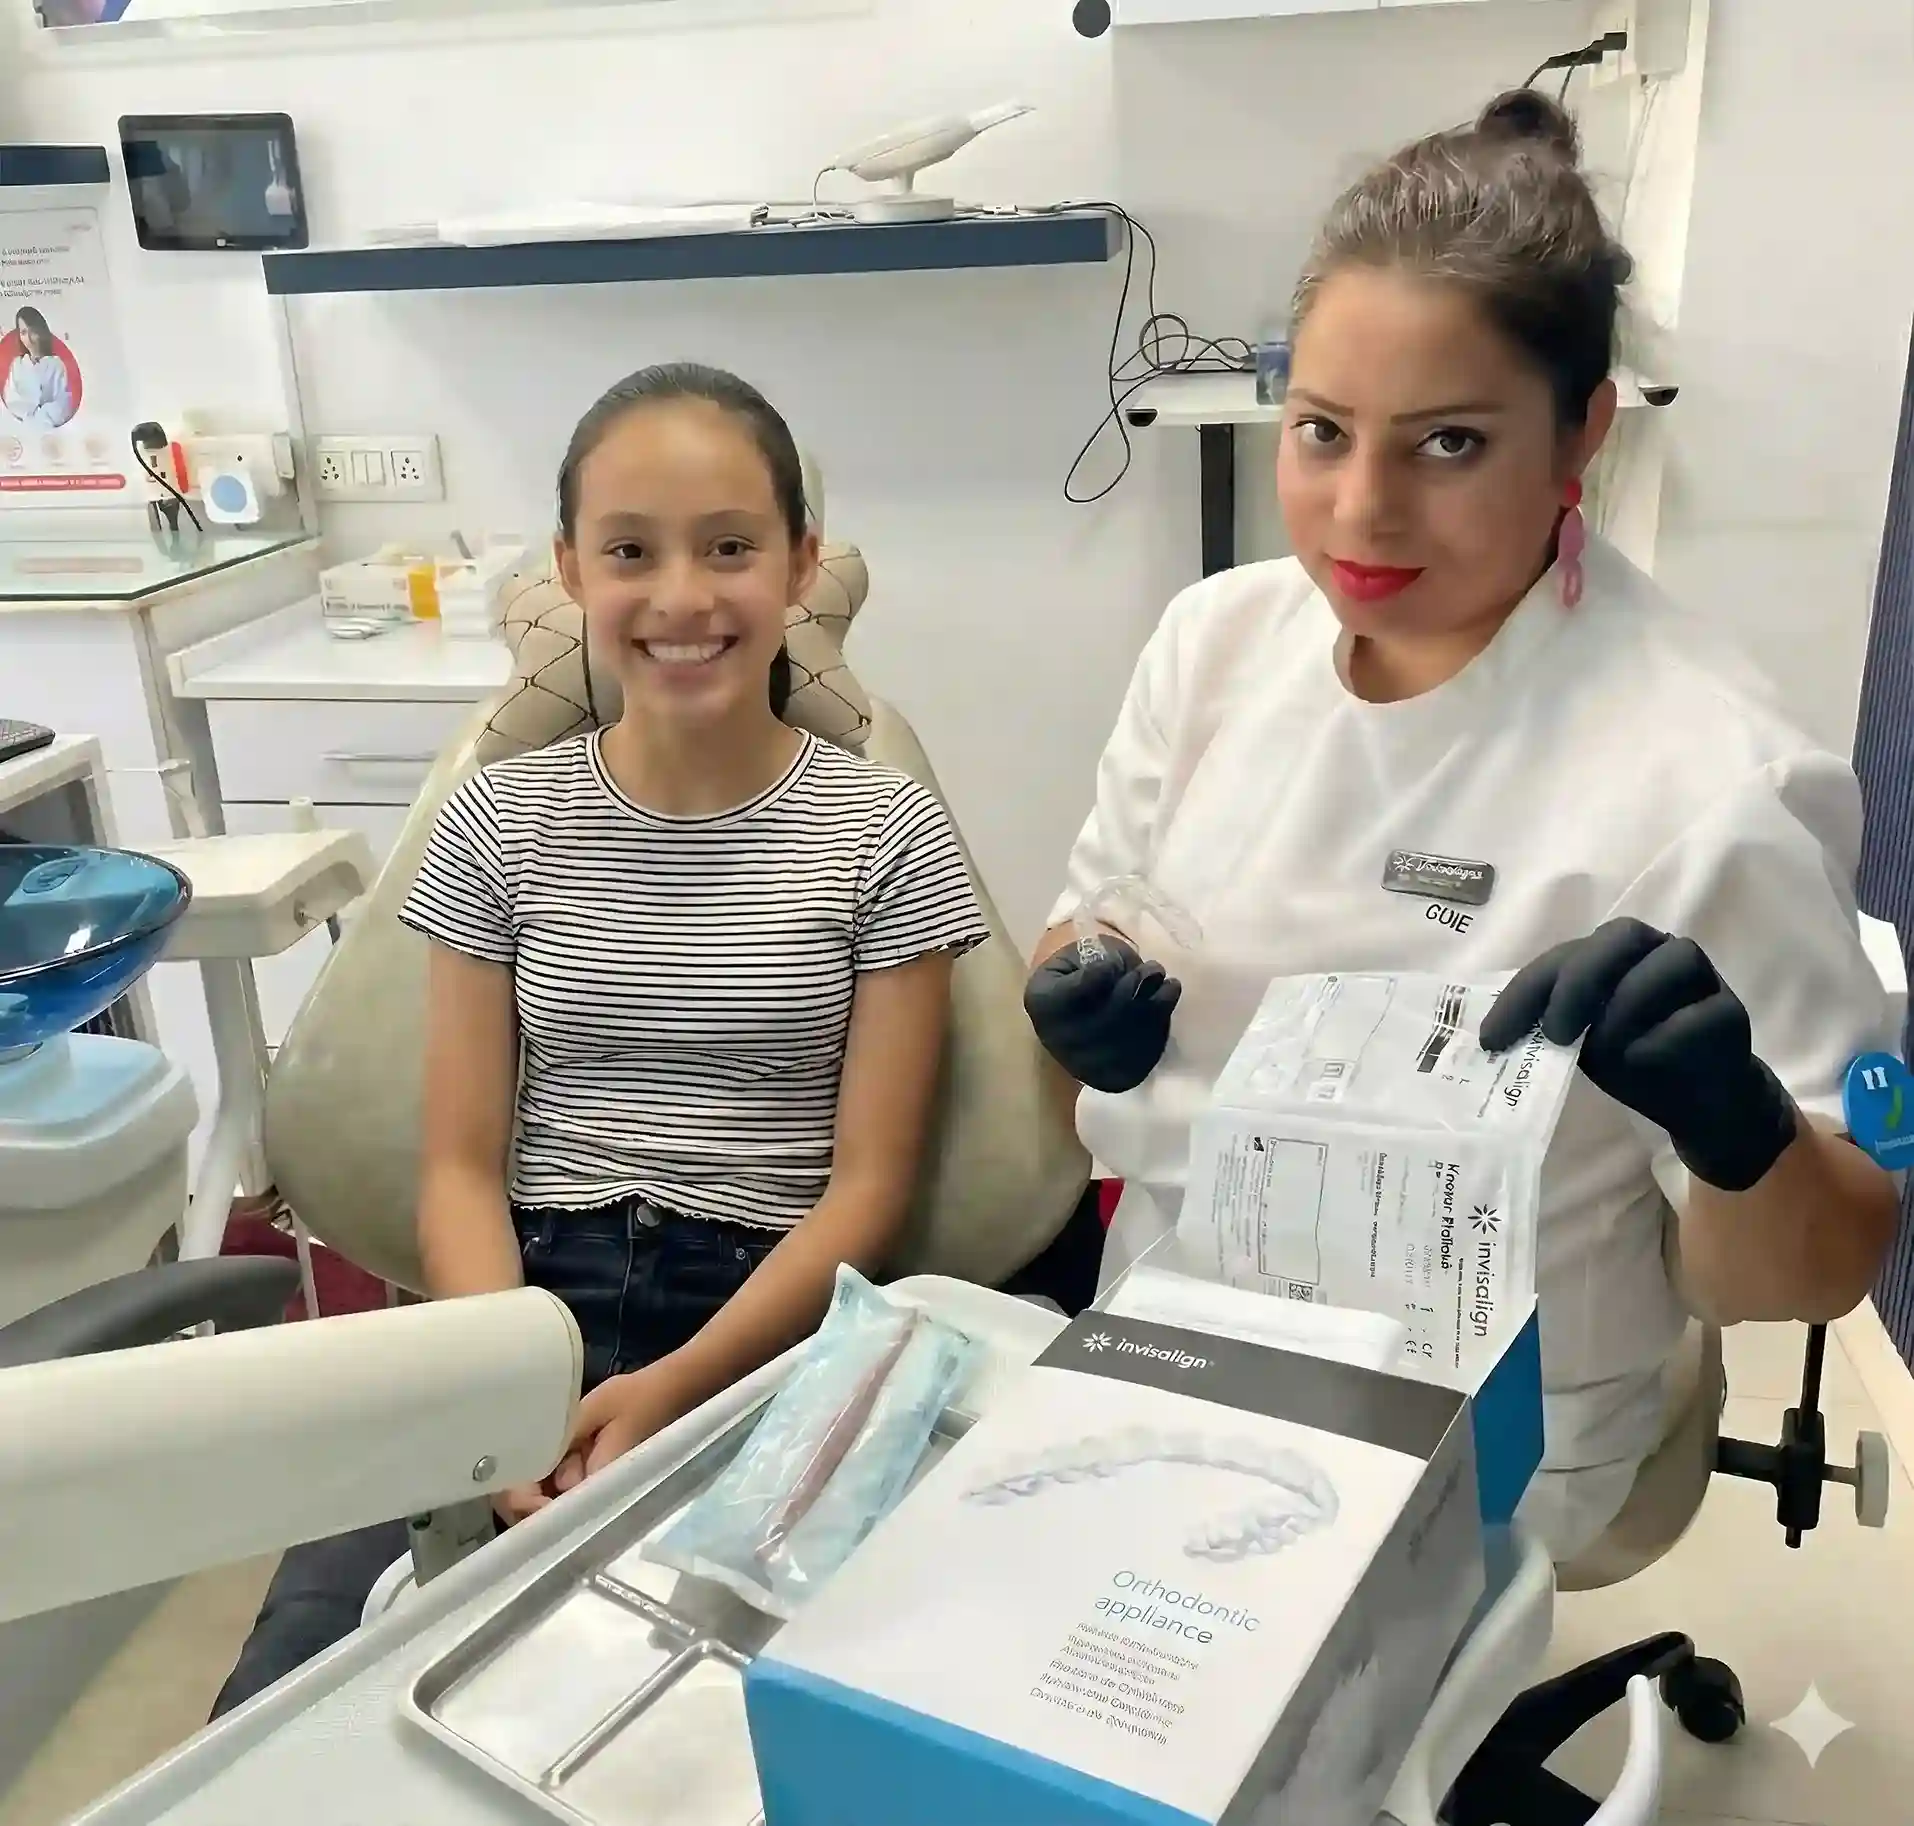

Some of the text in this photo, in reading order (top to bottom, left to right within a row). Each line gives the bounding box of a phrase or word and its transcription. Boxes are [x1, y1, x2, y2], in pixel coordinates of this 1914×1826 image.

[1469, 1241, 1497, 1338] invisalign
[1116, 1337, 1208, 1369] invisalign
[1094, 1596, 1214, 1645] appliance
[1113, 1570, 1261, 1632] Orthodontic
